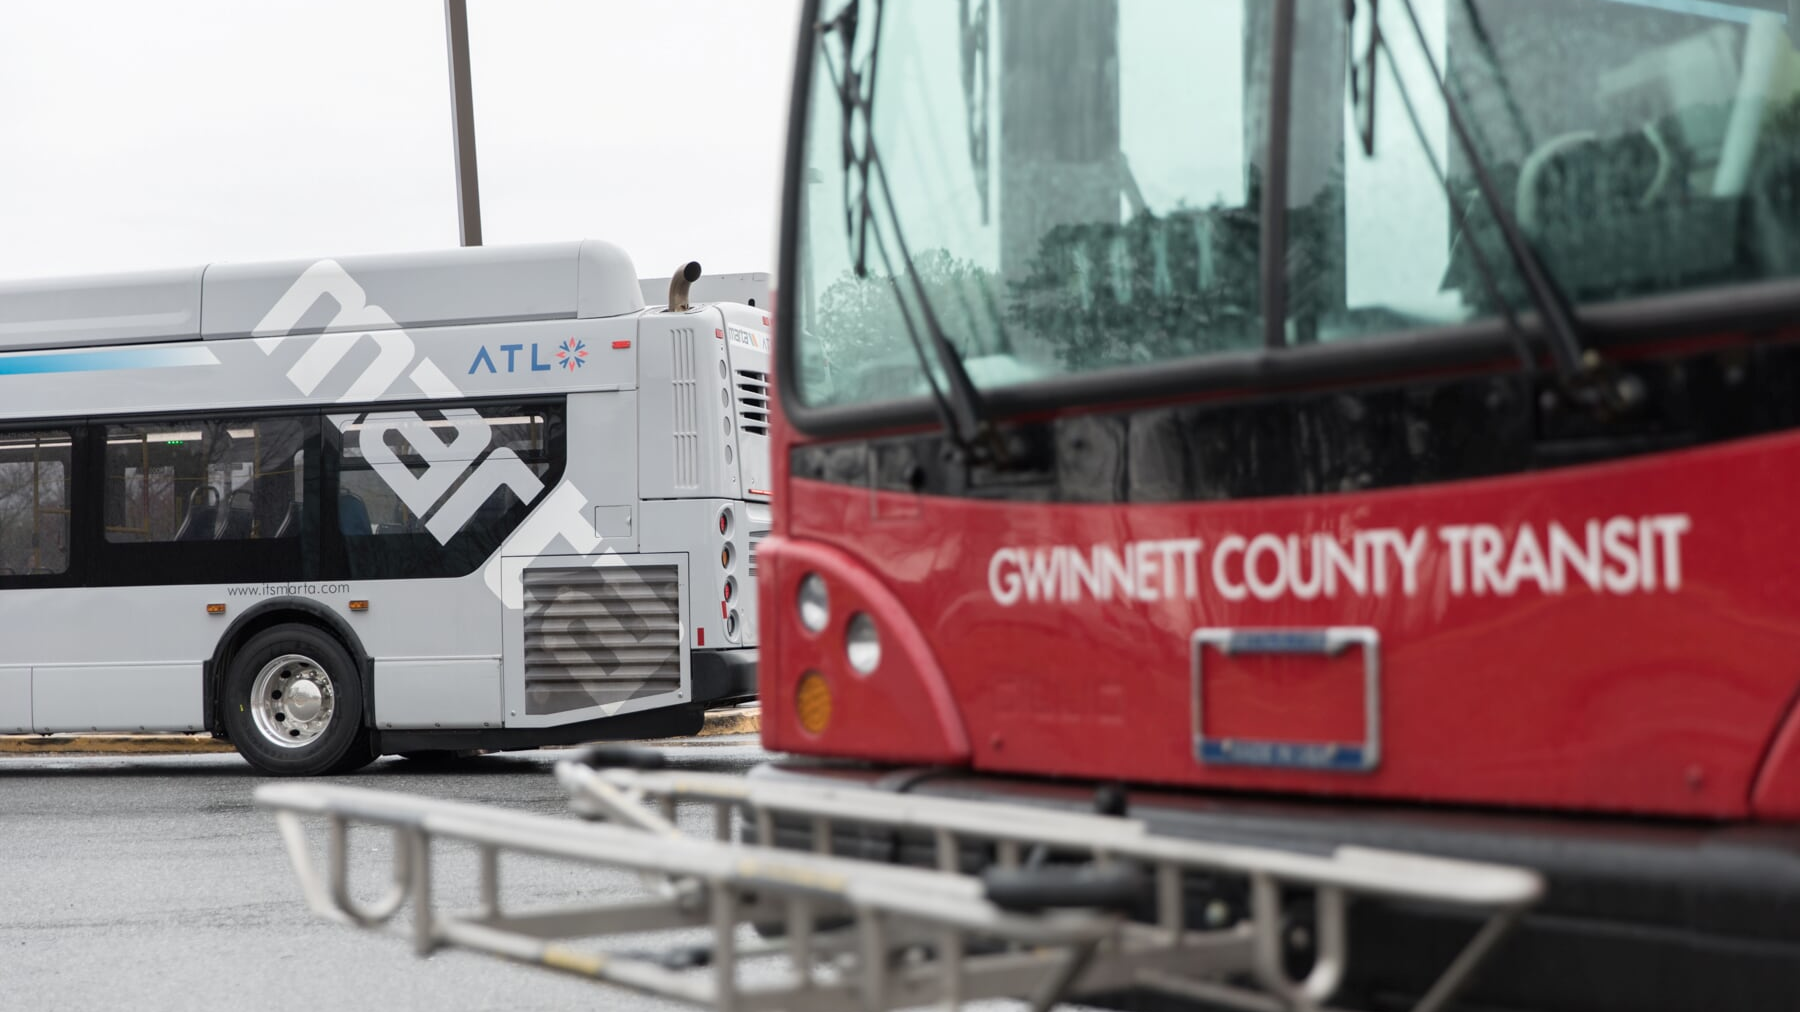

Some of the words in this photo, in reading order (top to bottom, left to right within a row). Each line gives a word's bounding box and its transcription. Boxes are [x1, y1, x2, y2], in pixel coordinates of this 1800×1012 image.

[468, 343, 552, 374] ATL
[251, 259, 684, 717] marta
[227, 583, 350, 596] www.itsmarta.com
[988, 539, 1202, 605] GWINNETT
[1212, 528, 1428, 600] COUNTY
[1439, 514, 1690, 595] TRANSIT
